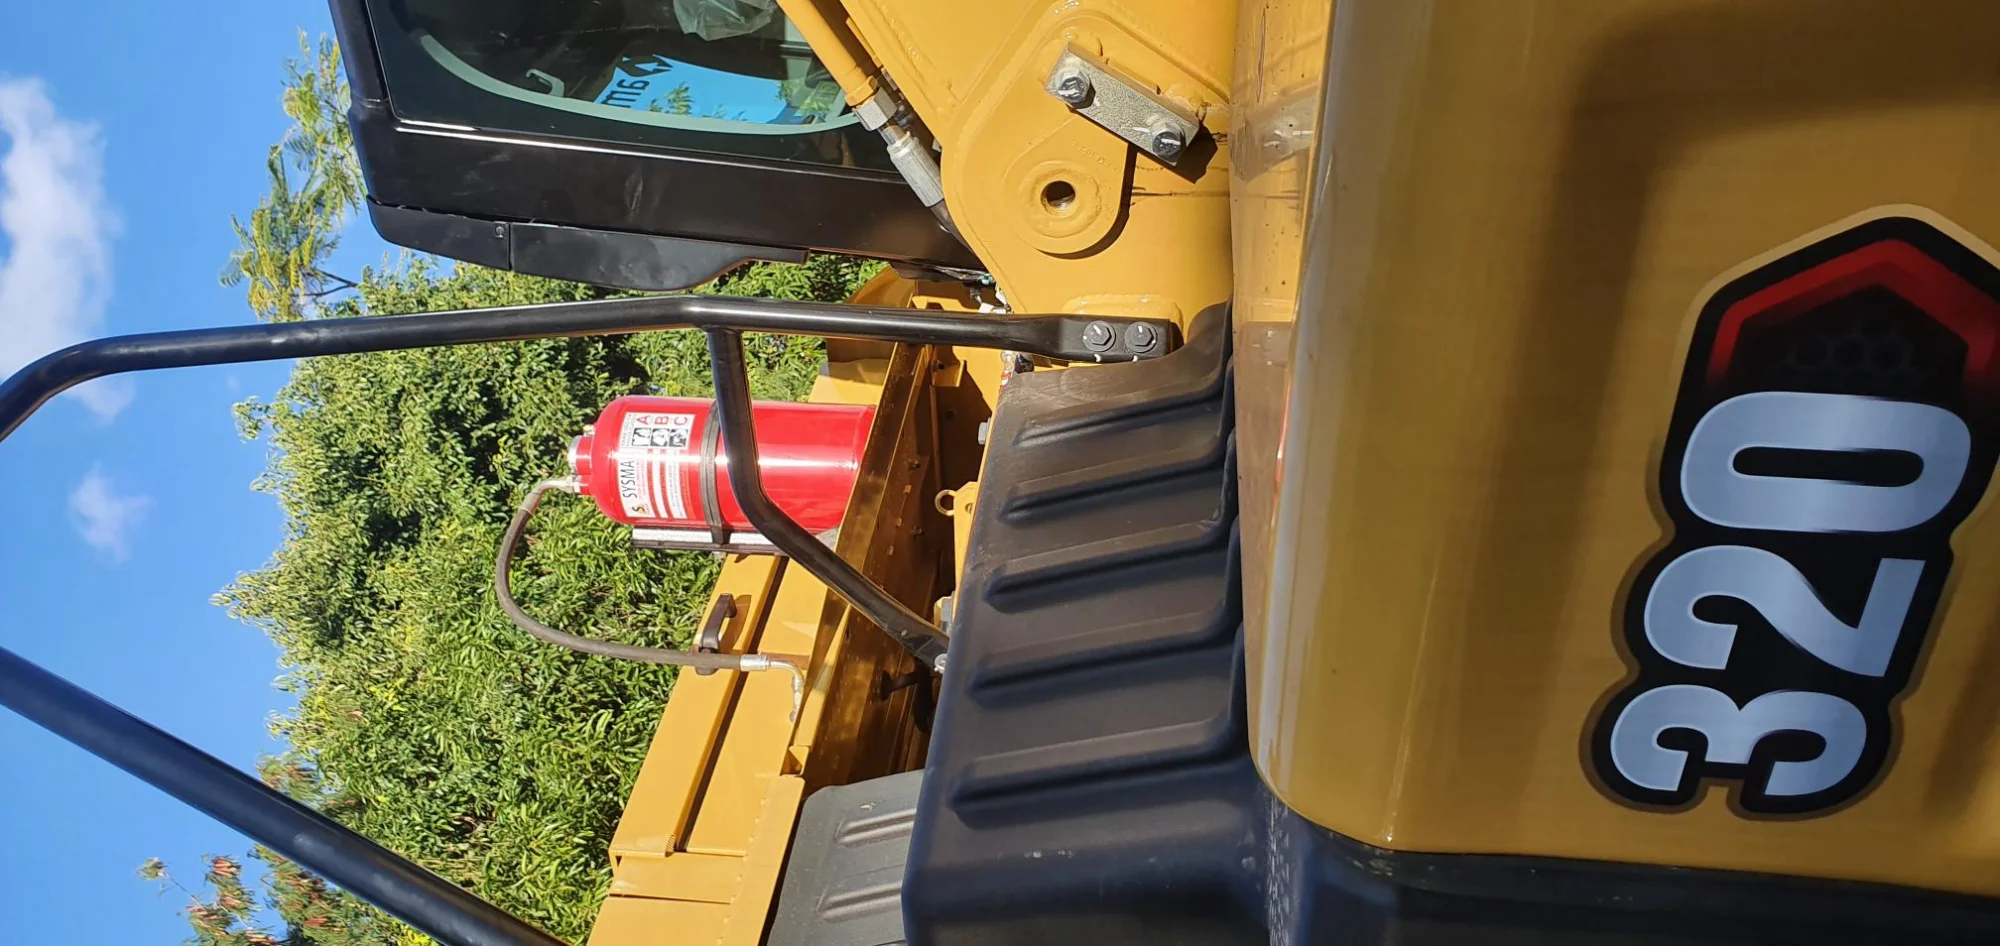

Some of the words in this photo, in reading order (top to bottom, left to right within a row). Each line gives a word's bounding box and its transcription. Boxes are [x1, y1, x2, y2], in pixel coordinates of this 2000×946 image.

[636, 415, 652, 425] A
[654, 415, 669, 425] B
[674, 416, 688, 426] C
[620, 452, 638, 499] SYSMA
[1610, 391, 1971, 796] 320
